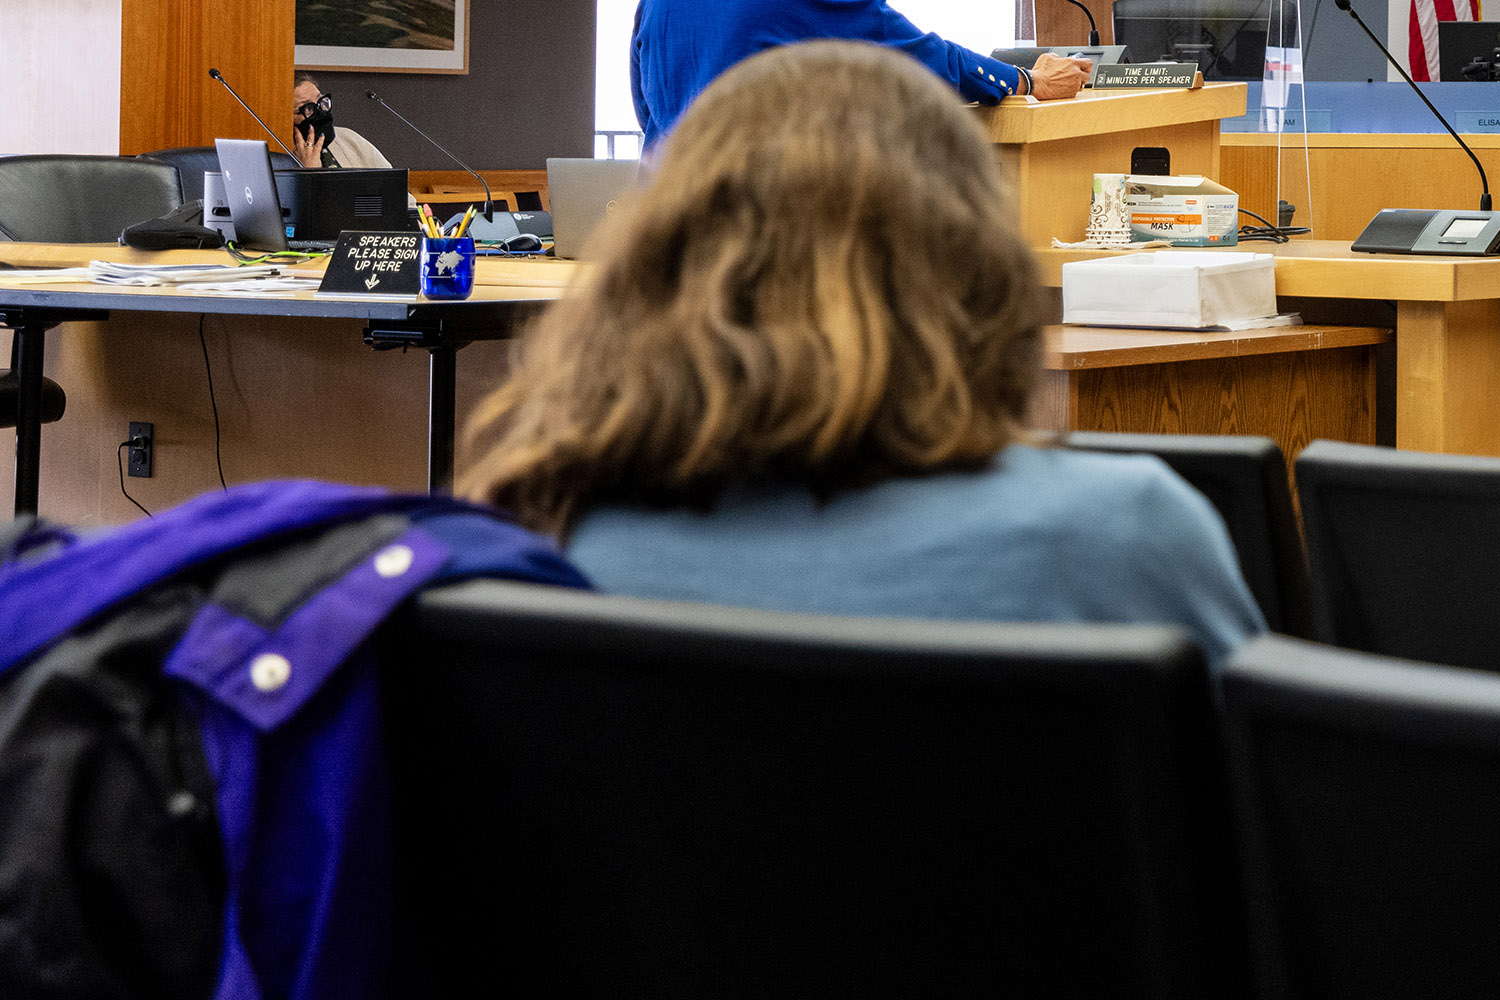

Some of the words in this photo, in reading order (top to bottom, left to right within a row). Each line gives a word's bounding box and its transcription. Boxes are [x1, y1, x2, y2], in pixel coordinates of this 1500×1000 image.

[1124, 67, 1142, 76] TIME
[1144, 67, 1169, 76] LIMIT:
[1098, 76, 1104, 84] 2
[1106, 76, 1139, 84] MINUTES
[1140, 76, 1155, 84] PER
[1157, 75, 1191, 84] SPEAKER
[1150, 222, 1174, 231] MASK
[358, 235, 418, 248] SPEAKERS
[347, 247, 393, 259] PLEASE
[393, 248, 420, 260] SIGN
[354, 260, 371, 271] UP
[372, 261, 403, 272] HERE
